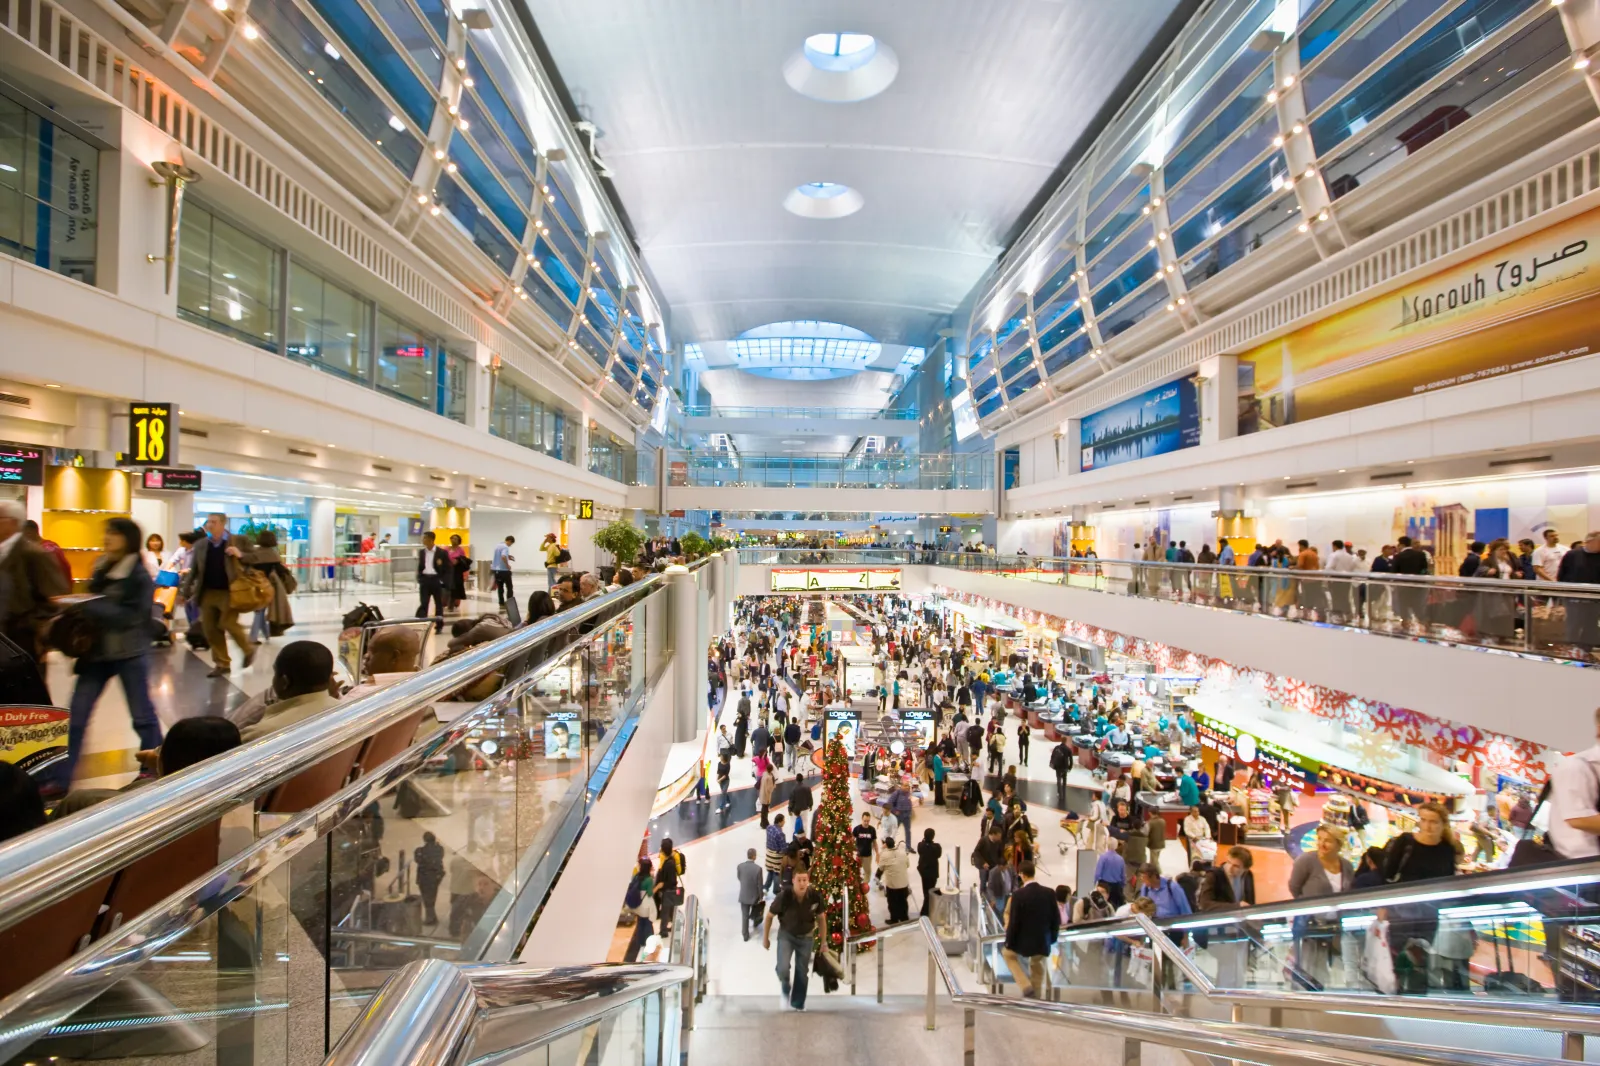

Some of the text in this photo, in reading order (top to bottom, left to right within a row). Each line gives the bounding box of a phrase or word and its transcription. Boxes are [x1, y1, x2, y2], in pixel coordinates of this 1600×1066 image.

[66, 156, 80, 243] Your gateway
[80, 168, 92, 215] growth
[1413, 272, 1485, 322] Sorouh
[1510, 346, 1589, 370] www.sorouh.com
[135, 418, 165, 461] 18
[582, 503, 592, 518] 16
[810, 577, 819, 587] A
[5, 712, 49, 722] Duty Free
[1203, 717, 1237, 736] FOOD
[1197, 723, 1236, 748] TOBACCO
[1217, 741, 1236, 759] FREE
